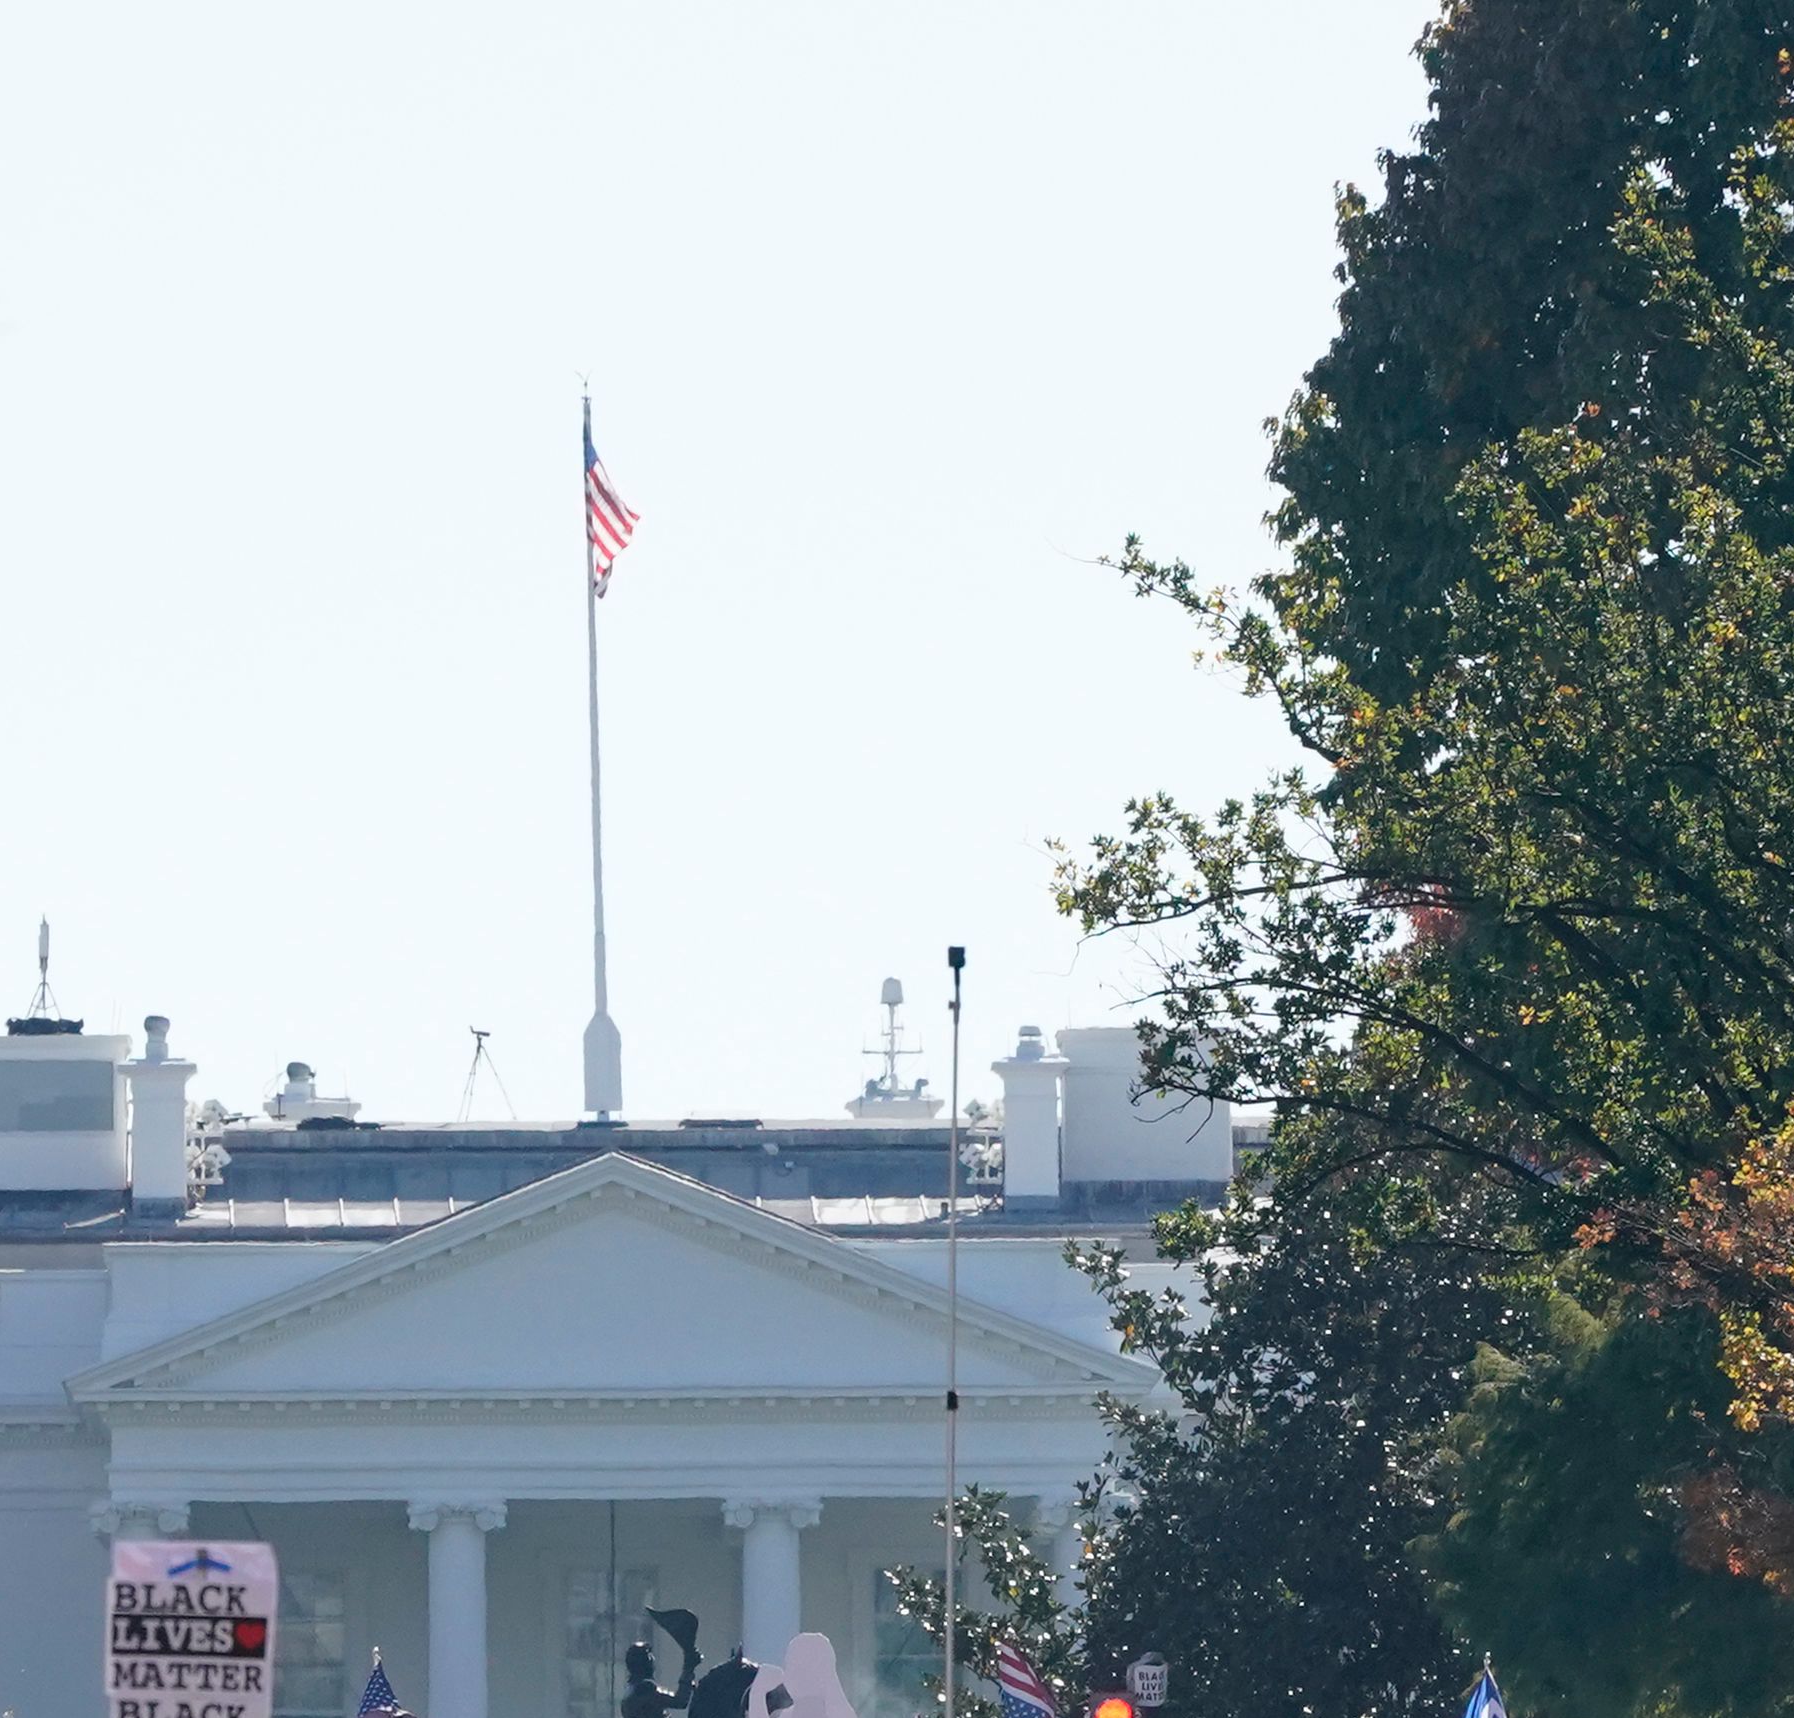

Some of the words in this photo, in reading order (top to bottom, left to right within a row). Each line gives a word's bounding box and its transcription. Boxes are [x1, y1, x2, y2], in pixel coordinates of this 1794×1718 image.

[115, 1584, 246, 1615] BLACK
[114, 1618, 234, 1653] LIVES
[113, 1662, 262, 1692] MATTER
